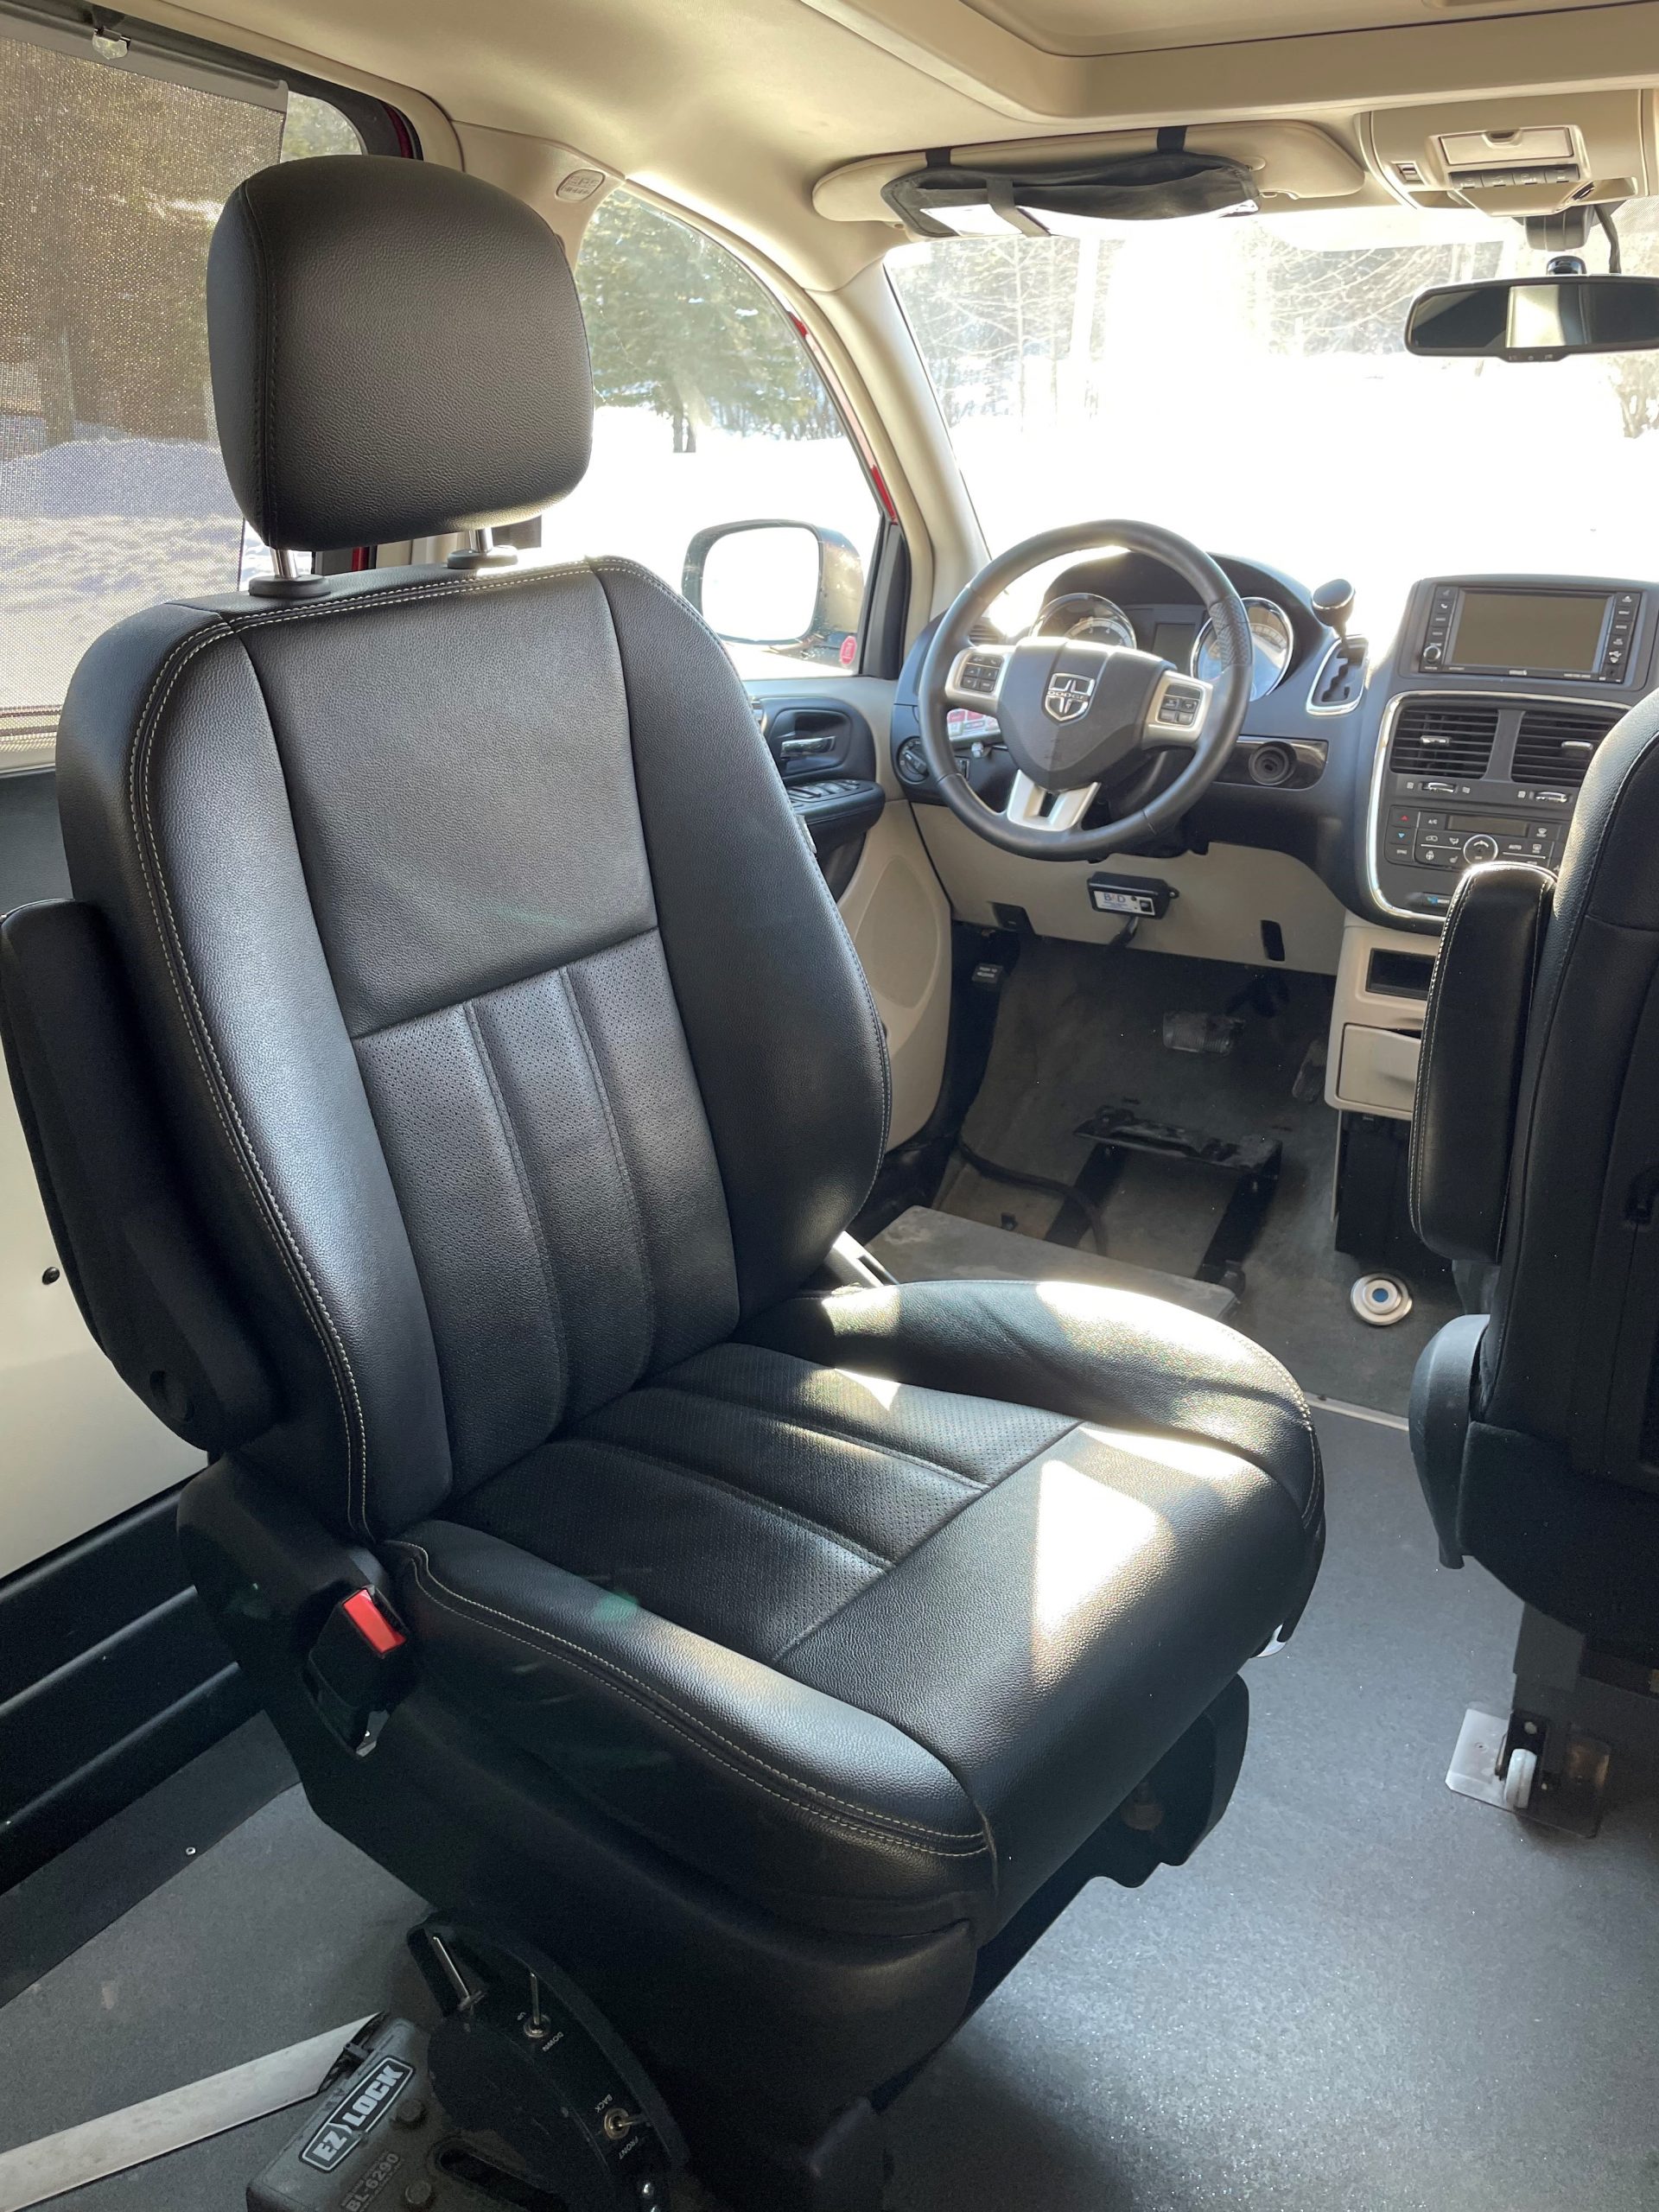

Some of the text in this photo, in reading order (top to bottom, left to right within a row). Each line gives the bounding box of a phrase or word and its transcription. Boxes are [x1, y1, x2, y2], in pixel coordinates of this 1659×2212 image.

[1046, 690, 1089, 702] DODGE
[542, 2031, 564, 2052] DOWN
[312, 2130, 347, 2161] EZ
[342, 2064, 404, 2126] LOCK
[594, 2094, 613, 2113] BACK
[618, 2135, 639, 2160] FRONT
[346, 2152, 400, 2212] BL-6290
